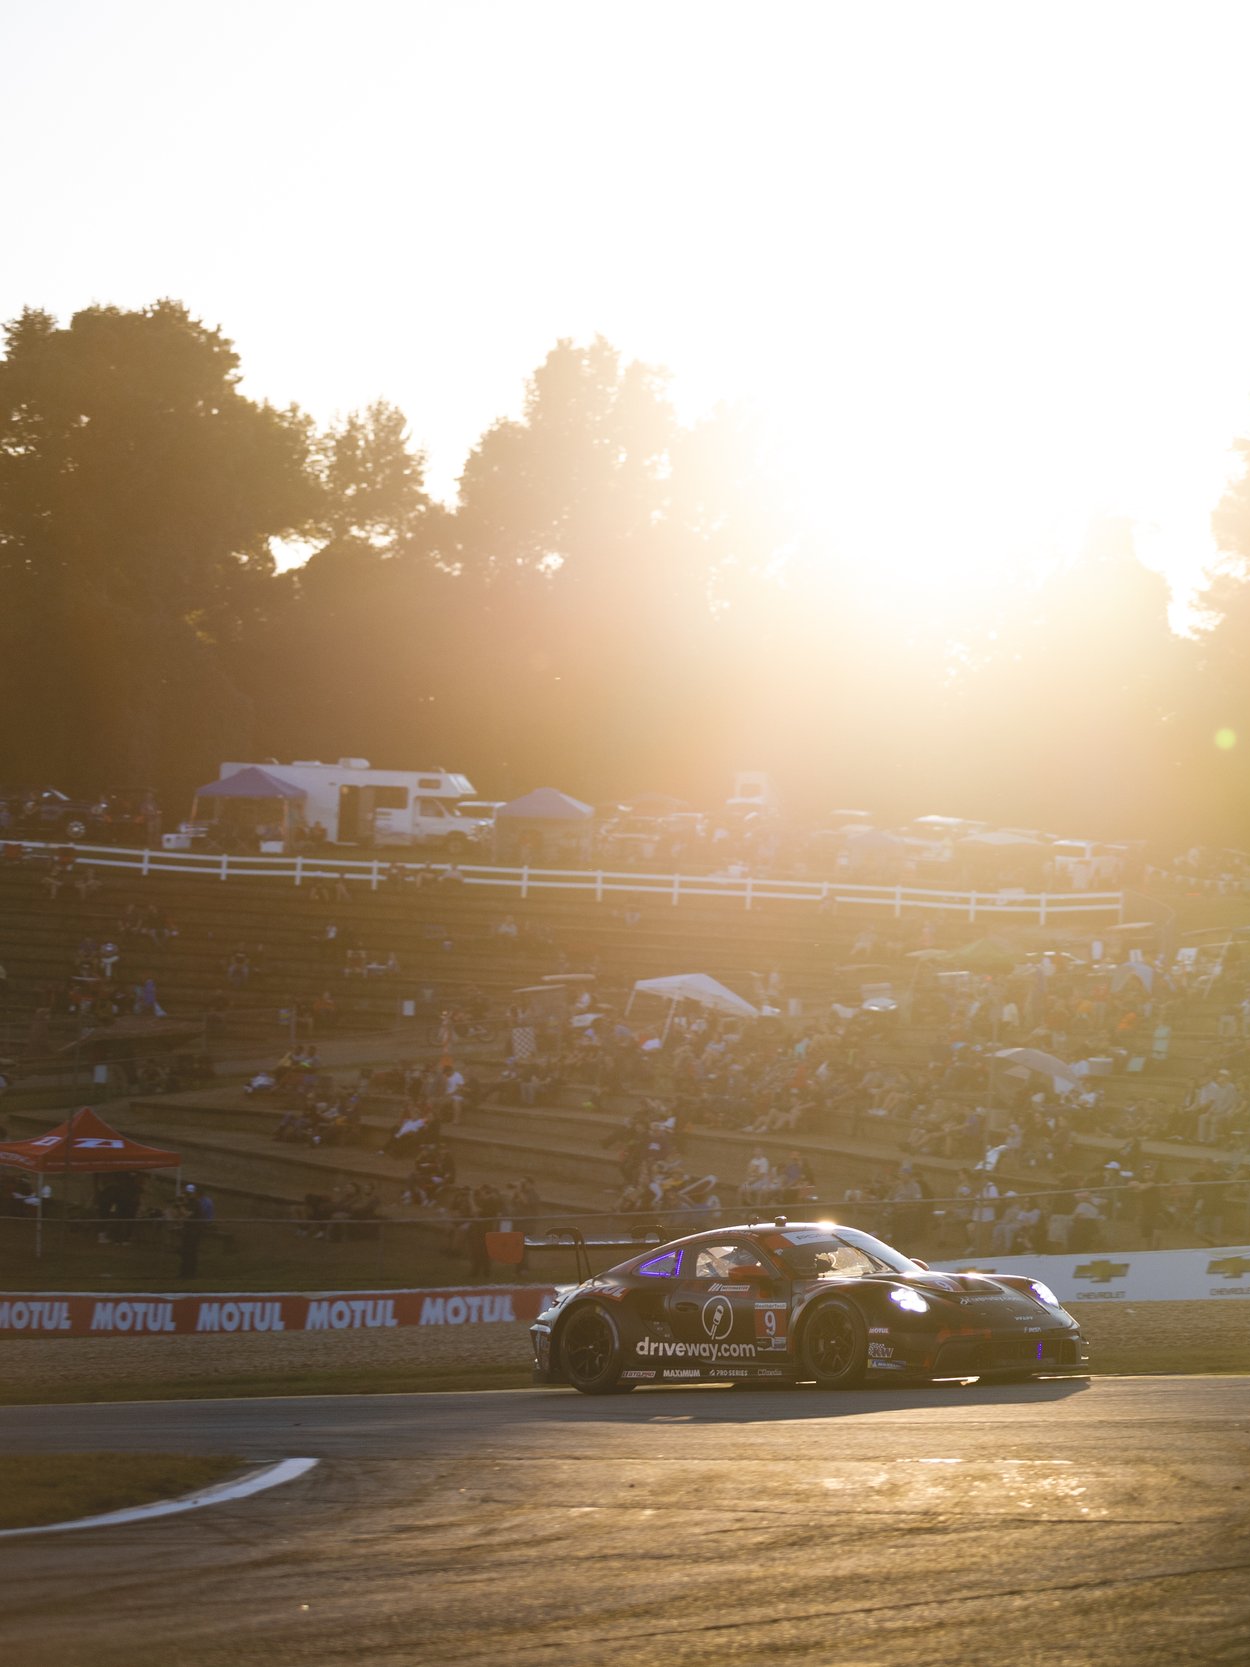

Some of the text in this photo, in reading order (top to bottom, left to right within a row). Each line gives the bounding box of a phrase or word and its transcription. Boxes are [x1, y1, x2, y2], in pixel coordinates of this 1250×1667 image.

[1076, 1290, 1126, 1300] CHEVROLET
[91, 1302, 176, 1331] MOTUL
[196, 1302, 285, 1332] MOTUL
[305, 1300, 398, 1331] MOTUL
[419, 1295, 516, 1325] MOTUL
[764, 1311, 776, 1336] 9
[636, 1336, 756, 1361] driveway.com
[663, 1369, 701, 1377] MAXIMUM
